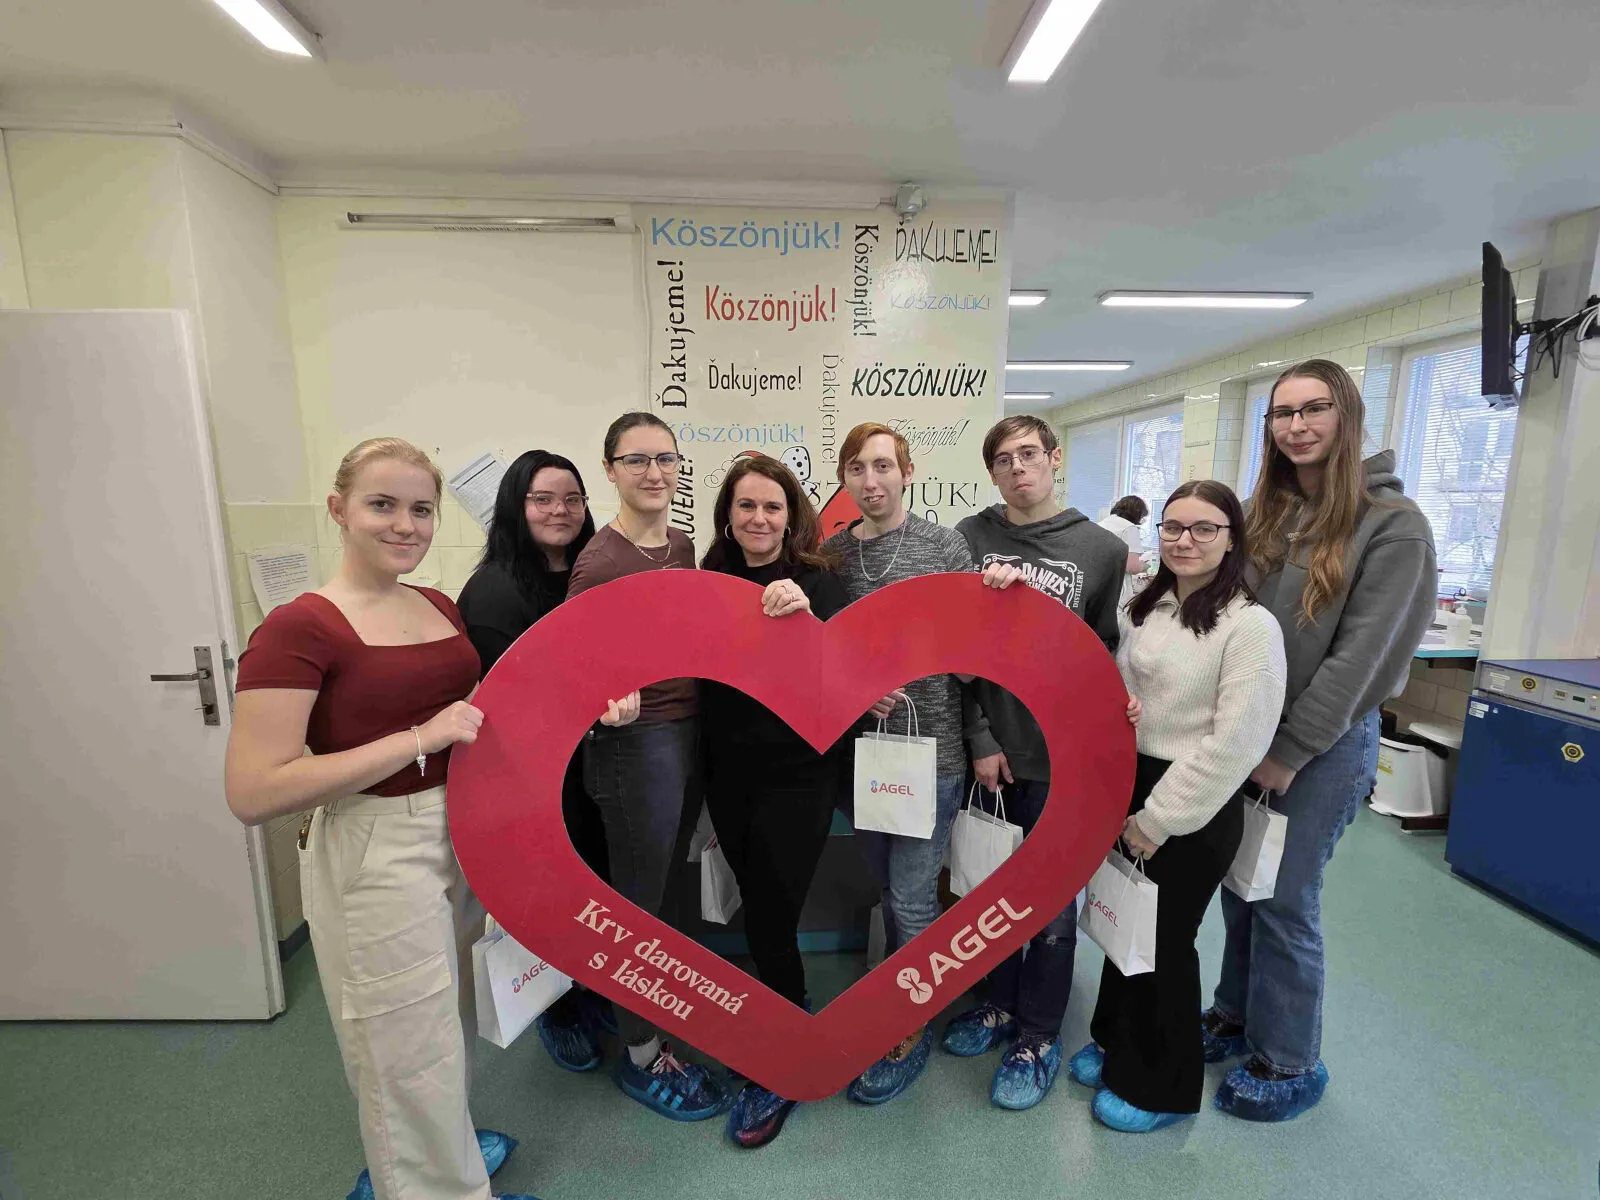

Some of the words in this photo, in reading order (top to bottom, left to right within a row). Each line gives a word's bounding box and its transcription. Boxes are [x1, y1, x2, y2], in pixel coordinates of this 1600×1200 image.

[651, 217, 840, 256] Köszönjük!
[895, 220, 998, 272] ĎAKUJEME!
[844, 224, 879, 336] Köszönjük!
[704, 284, 836, 332] Köszönjük!
[656, 260, 696, 408] Ďakujeme!
[708, 358, 802, 397] Ďakujeme!
[851, 363, 987, 397] KÖSZÖNJÜK!
[818, 354, 845, 463] Ďakujeme!
[666, 421, 804, 448] öszönjük!
[879, 783, 915, 796] AGEL
[1093, 900, 1119, 928] AGEL
[574, 899, 633, 943] Krv
[634, 938, 749, 1014] darovaná
[929, 897, 1034, 987] AGEL
[520, 960, 549, 987] AGE
[588, 952, 609, 970] s
[610, 959, 694, 1021] láskou
